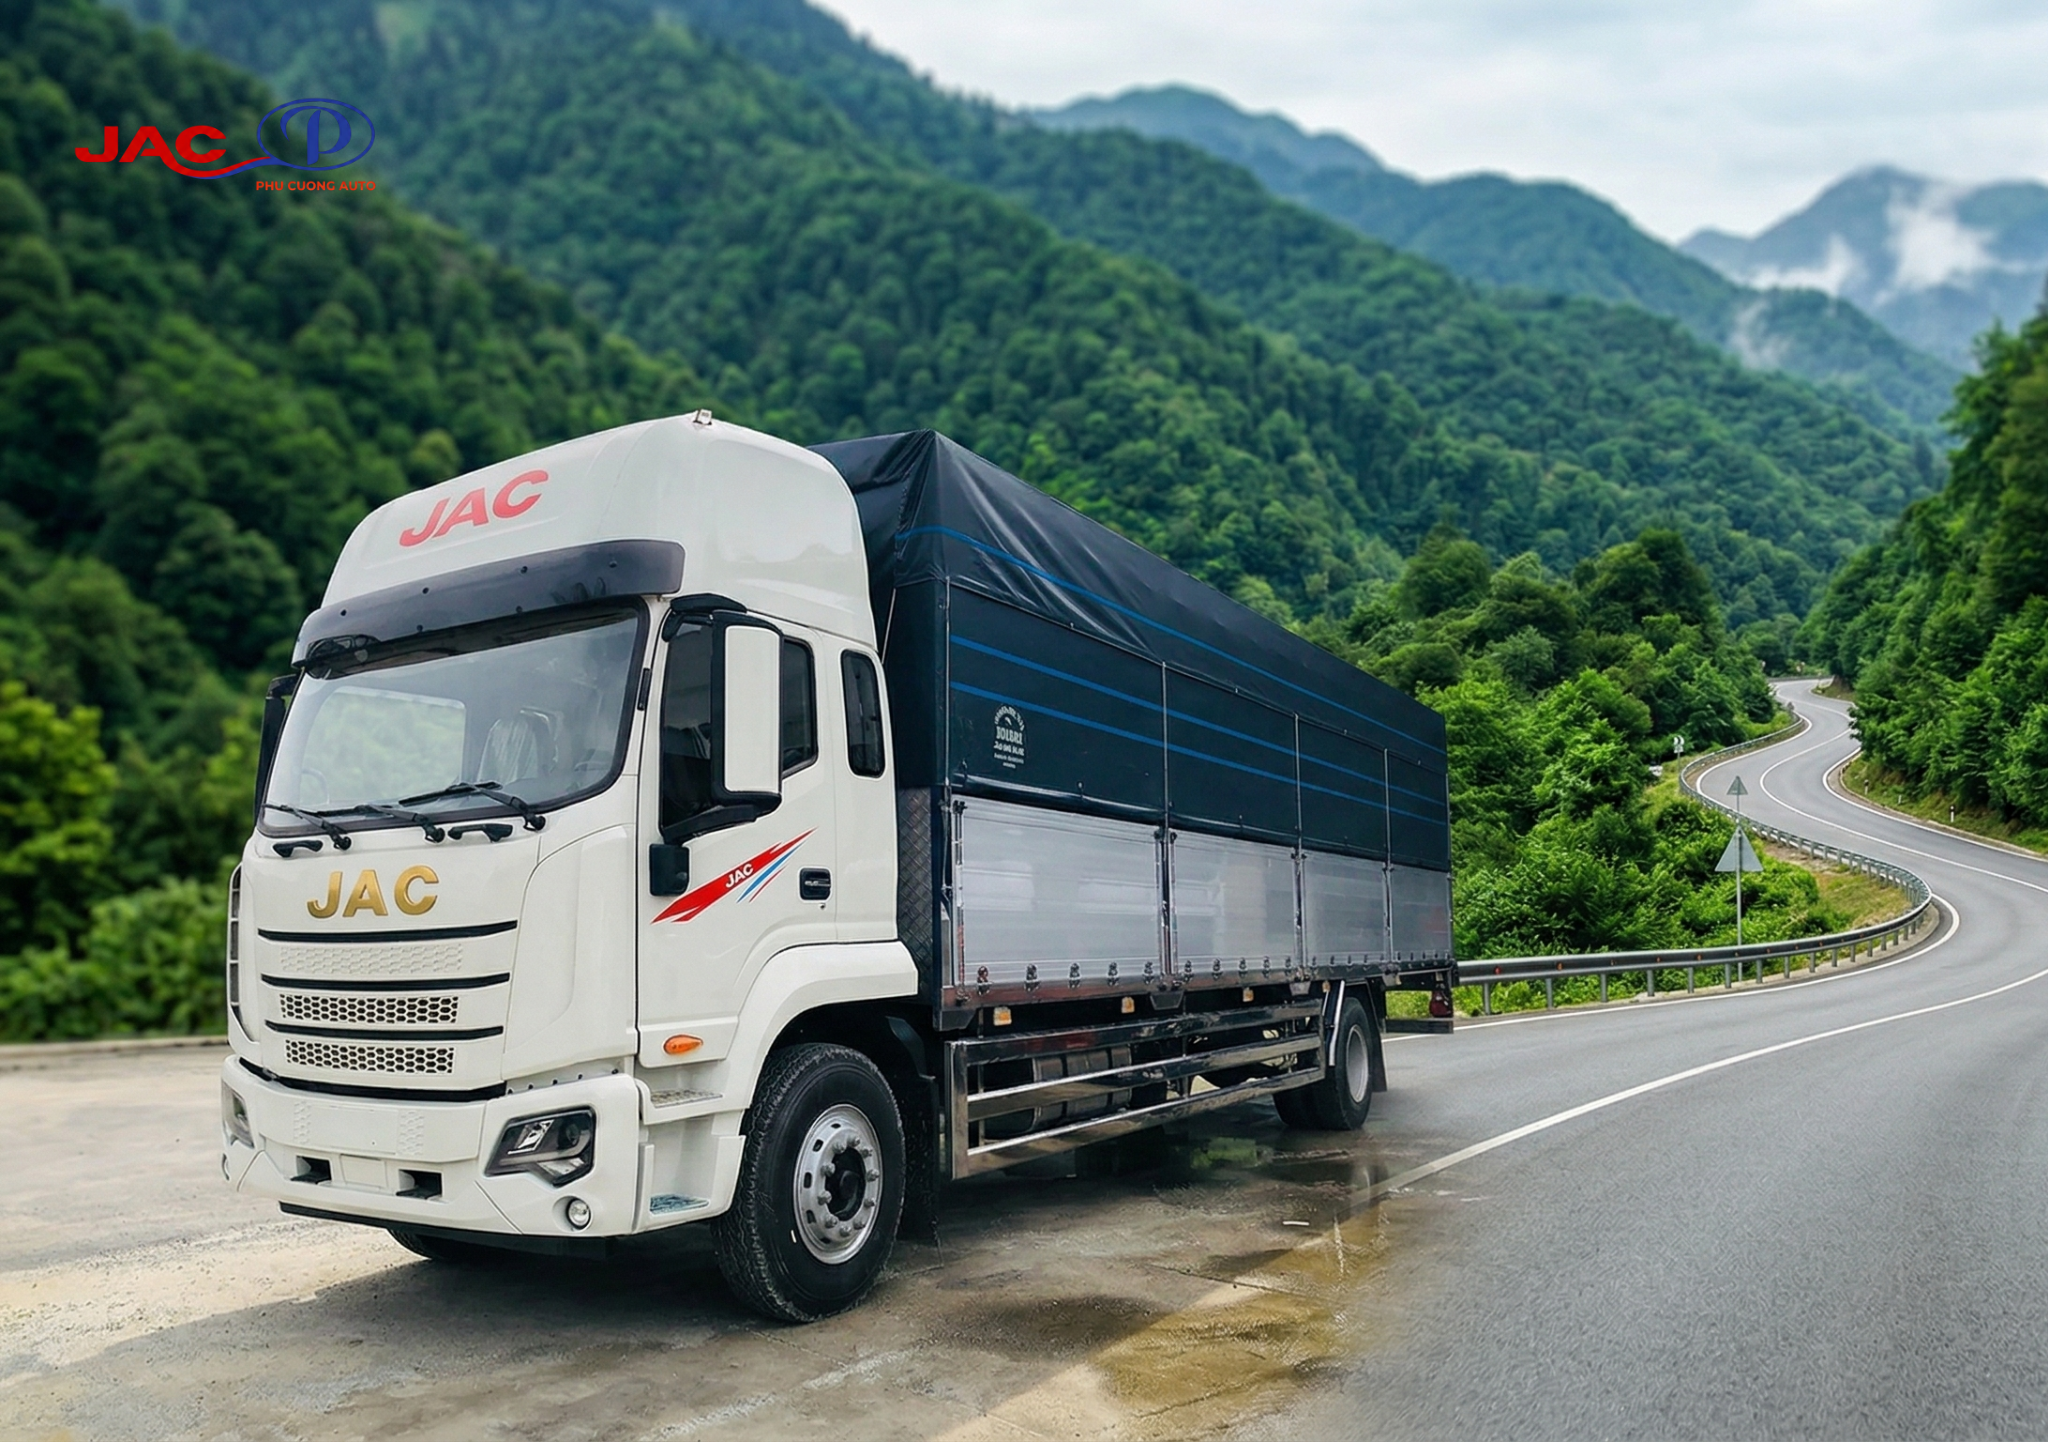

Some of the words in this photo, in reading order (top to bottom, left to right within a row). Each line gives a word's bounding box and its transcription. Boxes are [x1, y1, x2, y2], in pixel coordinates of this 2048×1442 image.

[399, 469, 549, 547] JAC
[307, 865, 439, 918] JAC
[725, 863, 754, 888] JAC
